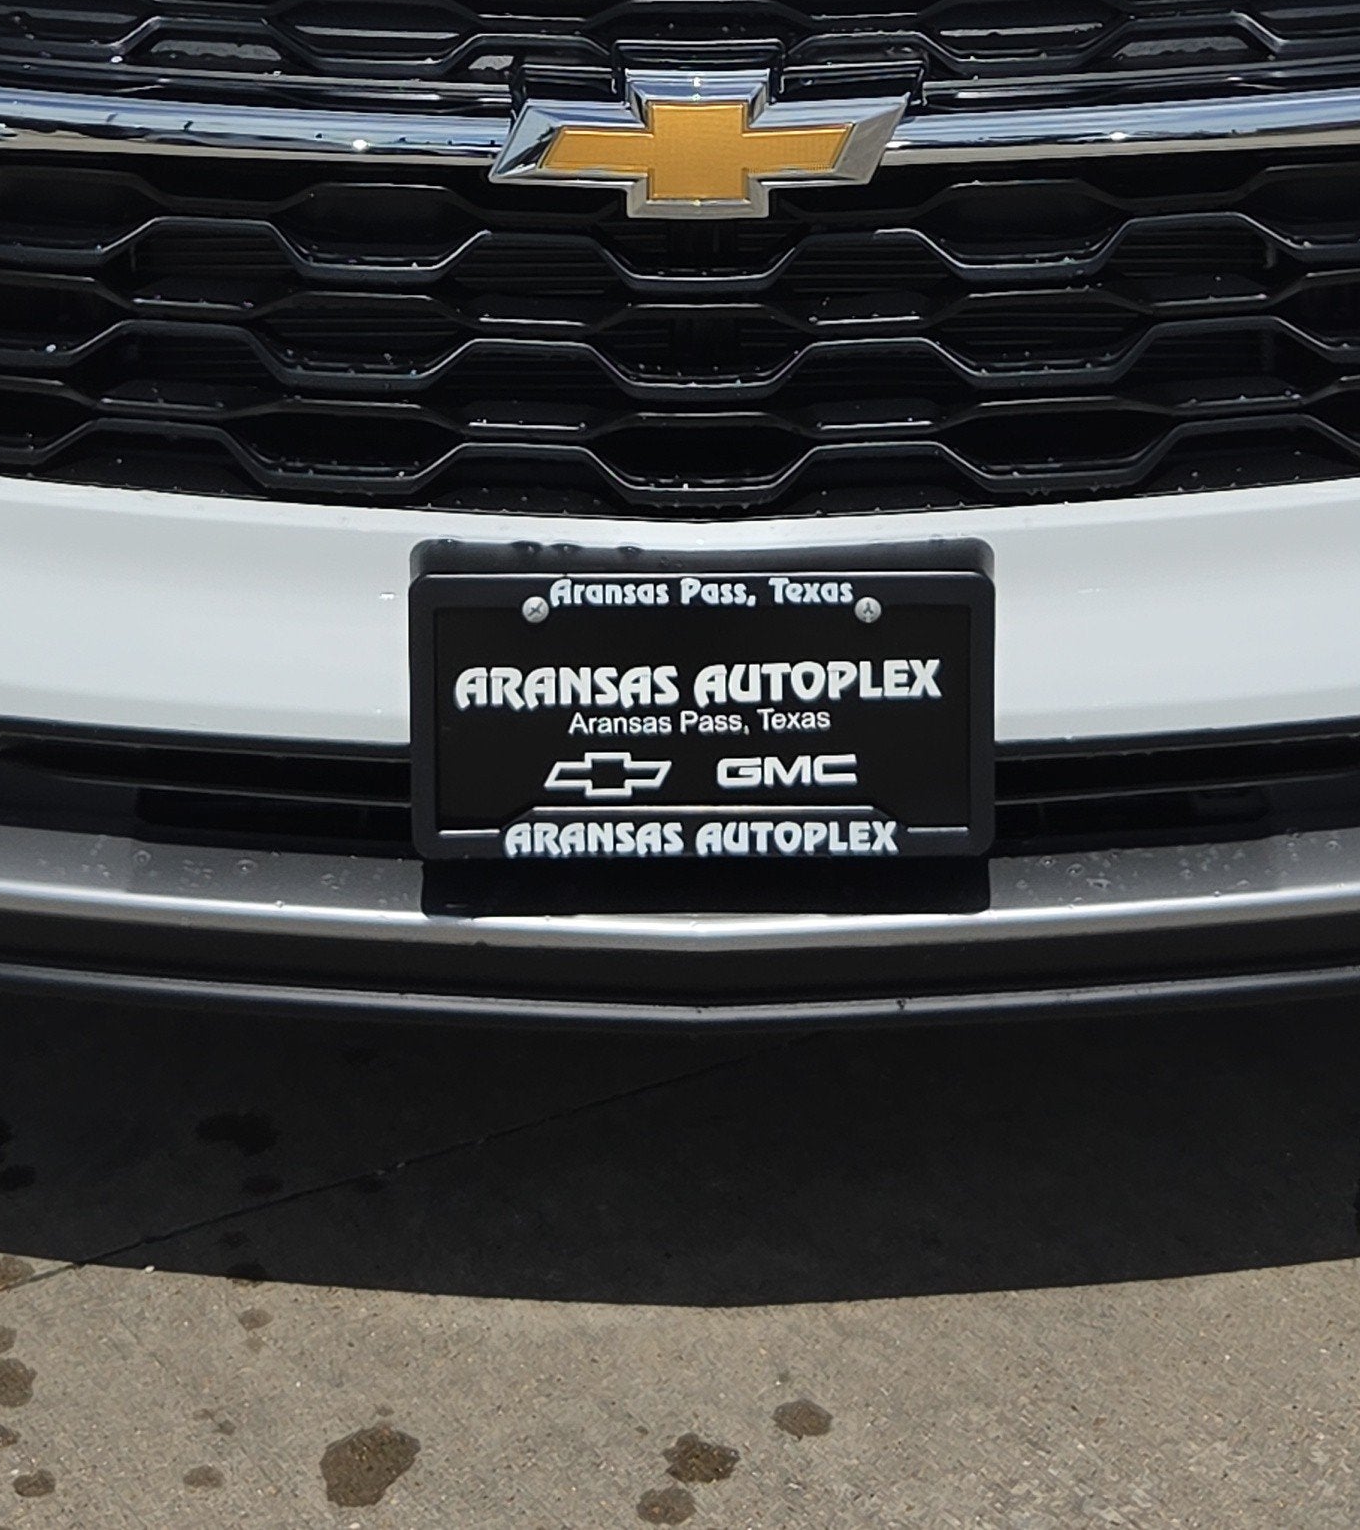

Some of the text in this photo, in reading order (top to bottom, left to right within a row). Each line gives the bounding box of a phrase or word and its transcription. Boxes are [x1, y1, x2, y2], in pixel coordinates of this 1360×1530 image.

[549, 576, 854, 608] Aransas Pass, Texas
[453, 659, 942, 711] ARANSAS AUTOPLEX
[568, 708, 832, 736] Aransas Pass, Texas
[716, 754, 858, 788] GMC
[503, 820, 899, 858] ARANSAS AUTOPLEX
